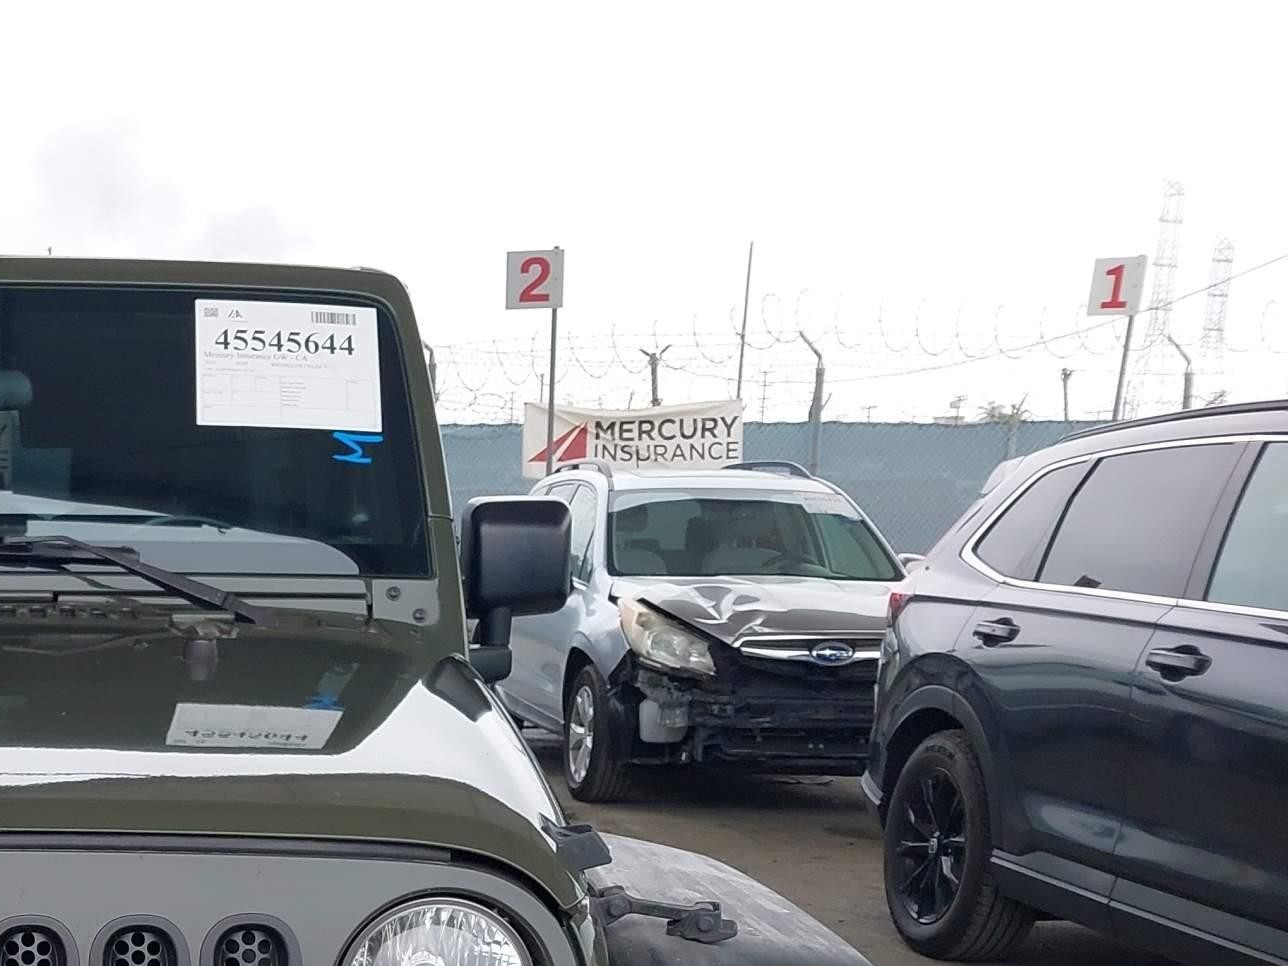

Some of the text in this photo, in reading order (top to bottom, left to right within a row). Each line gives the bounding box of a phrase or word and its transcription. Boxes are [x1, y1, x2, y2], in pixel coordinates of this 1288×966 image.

[519, 256, 551, 303] 2
[1100, 264, 1128, 309] 1
[215, 328, 355, 356] 45545644
[594, 416, 740, 441] MERCURY
[594, 441, 739, 463] INSURANCE
